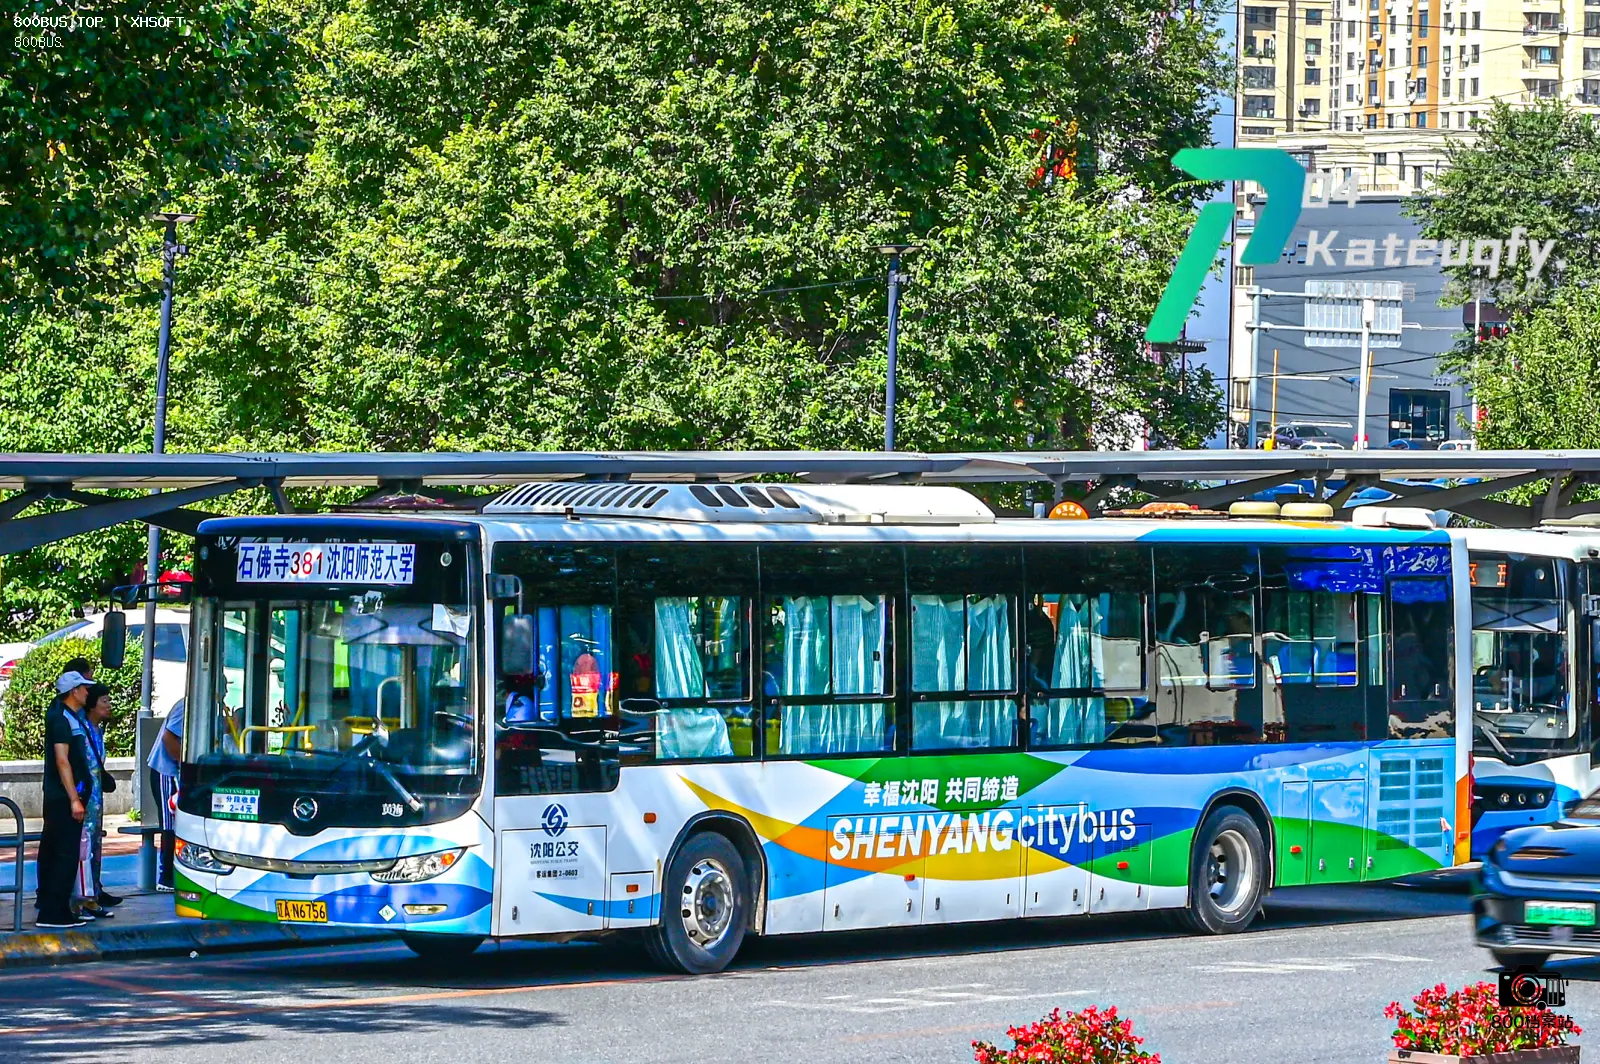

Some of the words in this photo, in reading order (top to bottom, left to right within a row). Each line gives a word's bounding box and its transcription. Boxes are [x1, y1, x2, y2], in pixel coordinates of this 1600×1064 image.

[238, 545, 291, 580] 石佛寺
[290, 551, 324, 575] 381
[326, 544, 413, 582] 沈阳师范大学
[863, 778, 940, 807] 幸福沈阳
[944, 774, 1019, 804] 共同缔造
[381, 802, 404, 818] 黄海
[829, 810, 1014, 861] SHENYANG
[1017, 801, 1137, 854] citybus
[530, 841, 579, 859] 沈阳公交
